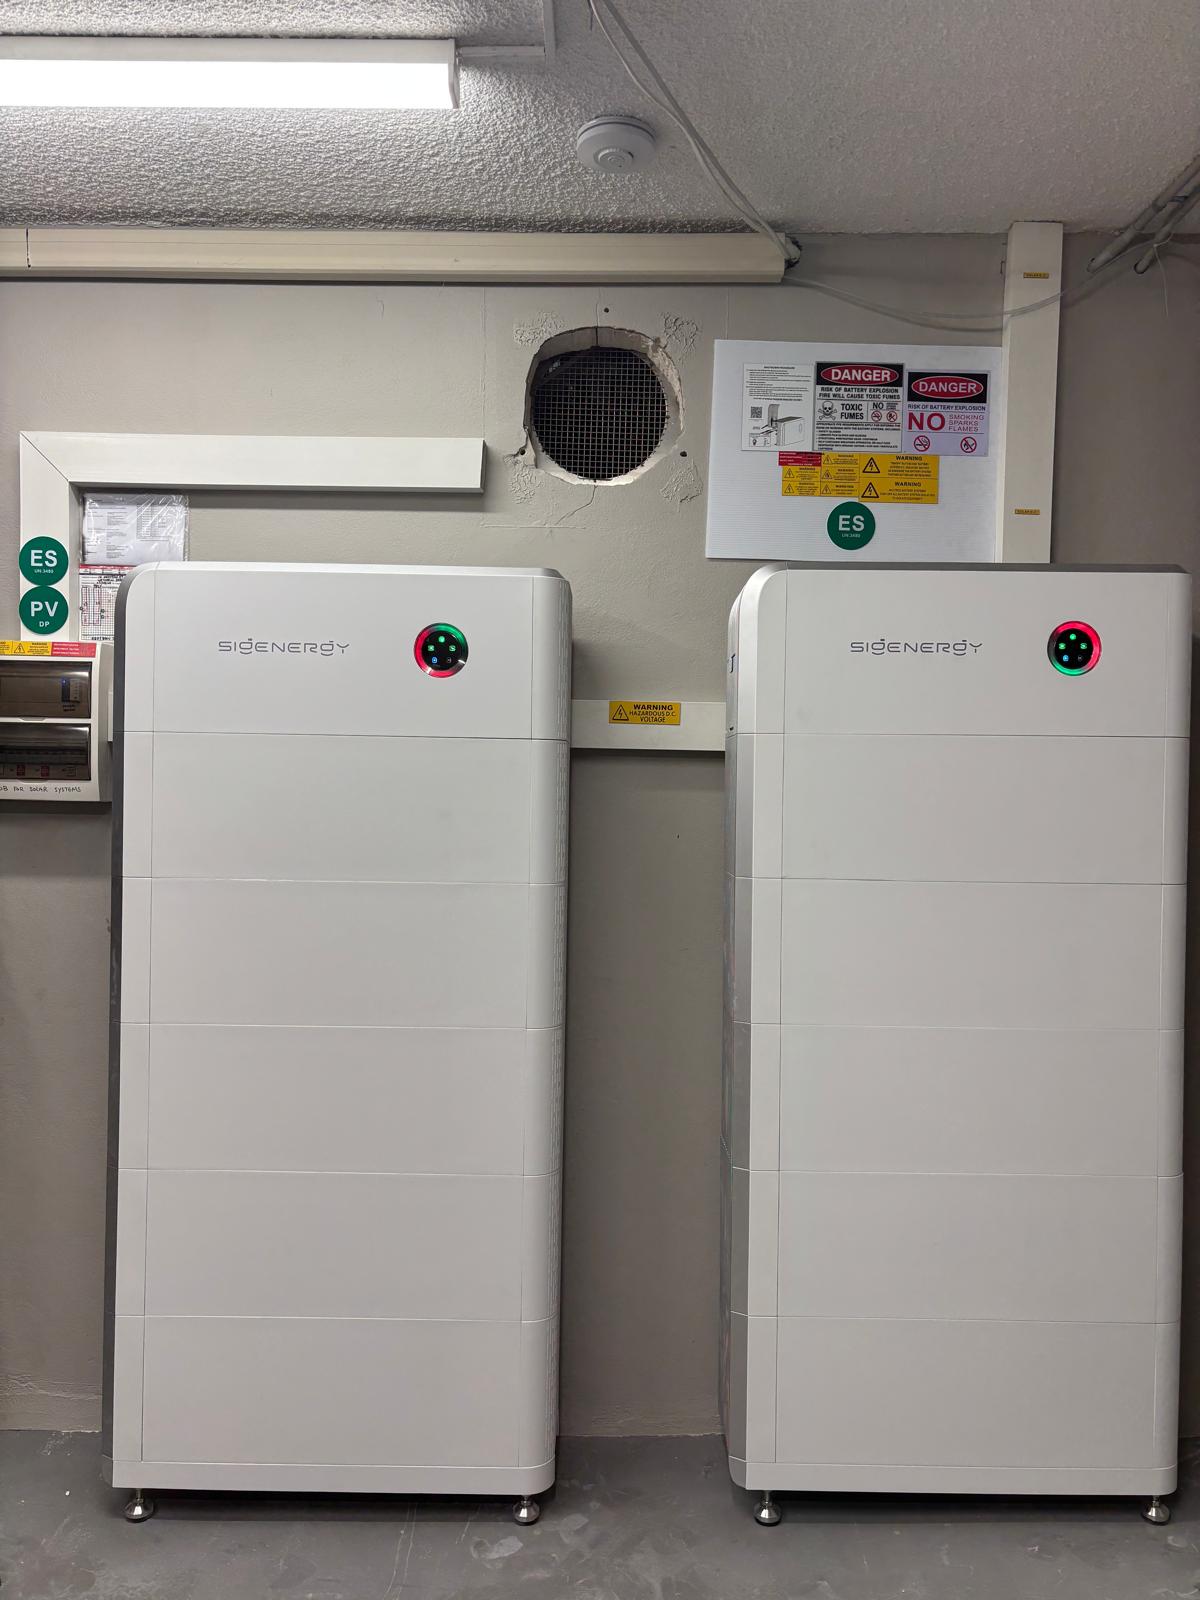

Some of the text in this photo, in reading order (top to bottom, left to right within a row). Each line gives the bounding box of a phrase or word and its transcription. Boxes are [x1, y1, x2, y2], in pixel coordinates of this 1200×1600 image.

[831, 369, 891, 382] DANGER
[920, 382, 977, 393] DANGER
[840, 403, 863, 412] TOXIC
[872, 402, 884, 410] NO
[840, 412, 864, 420] FUMES
[908, 412, 946, 432] NO
[838, 514, 864, 532] ES
[30, 550, 58, 567] ES
[30, 601, 58, 617] PV
